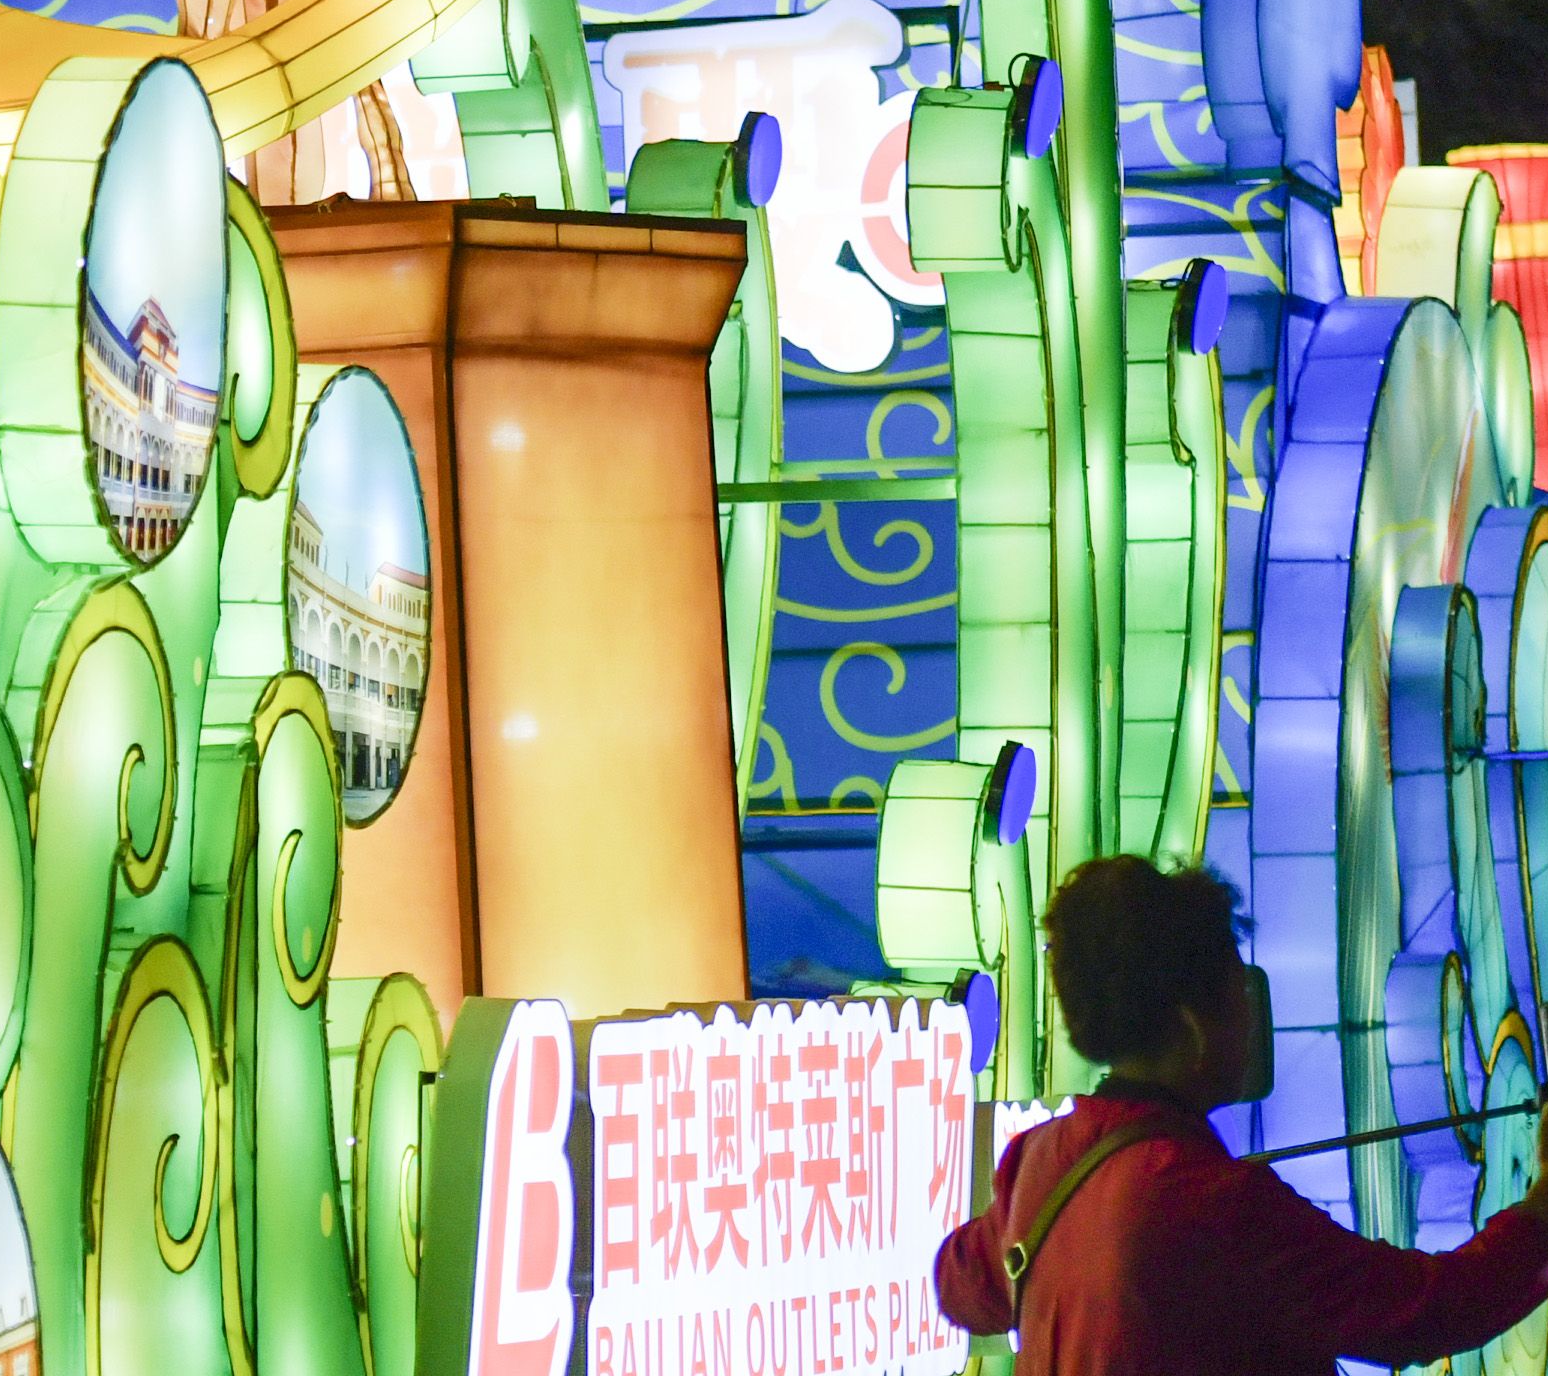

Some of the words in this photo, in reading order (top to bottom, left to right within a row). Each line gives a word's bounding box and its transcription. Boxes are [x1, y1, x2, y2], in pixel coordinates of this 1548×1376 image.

[596, 1028, 966, 1288] 百联奥特莱斯广场
